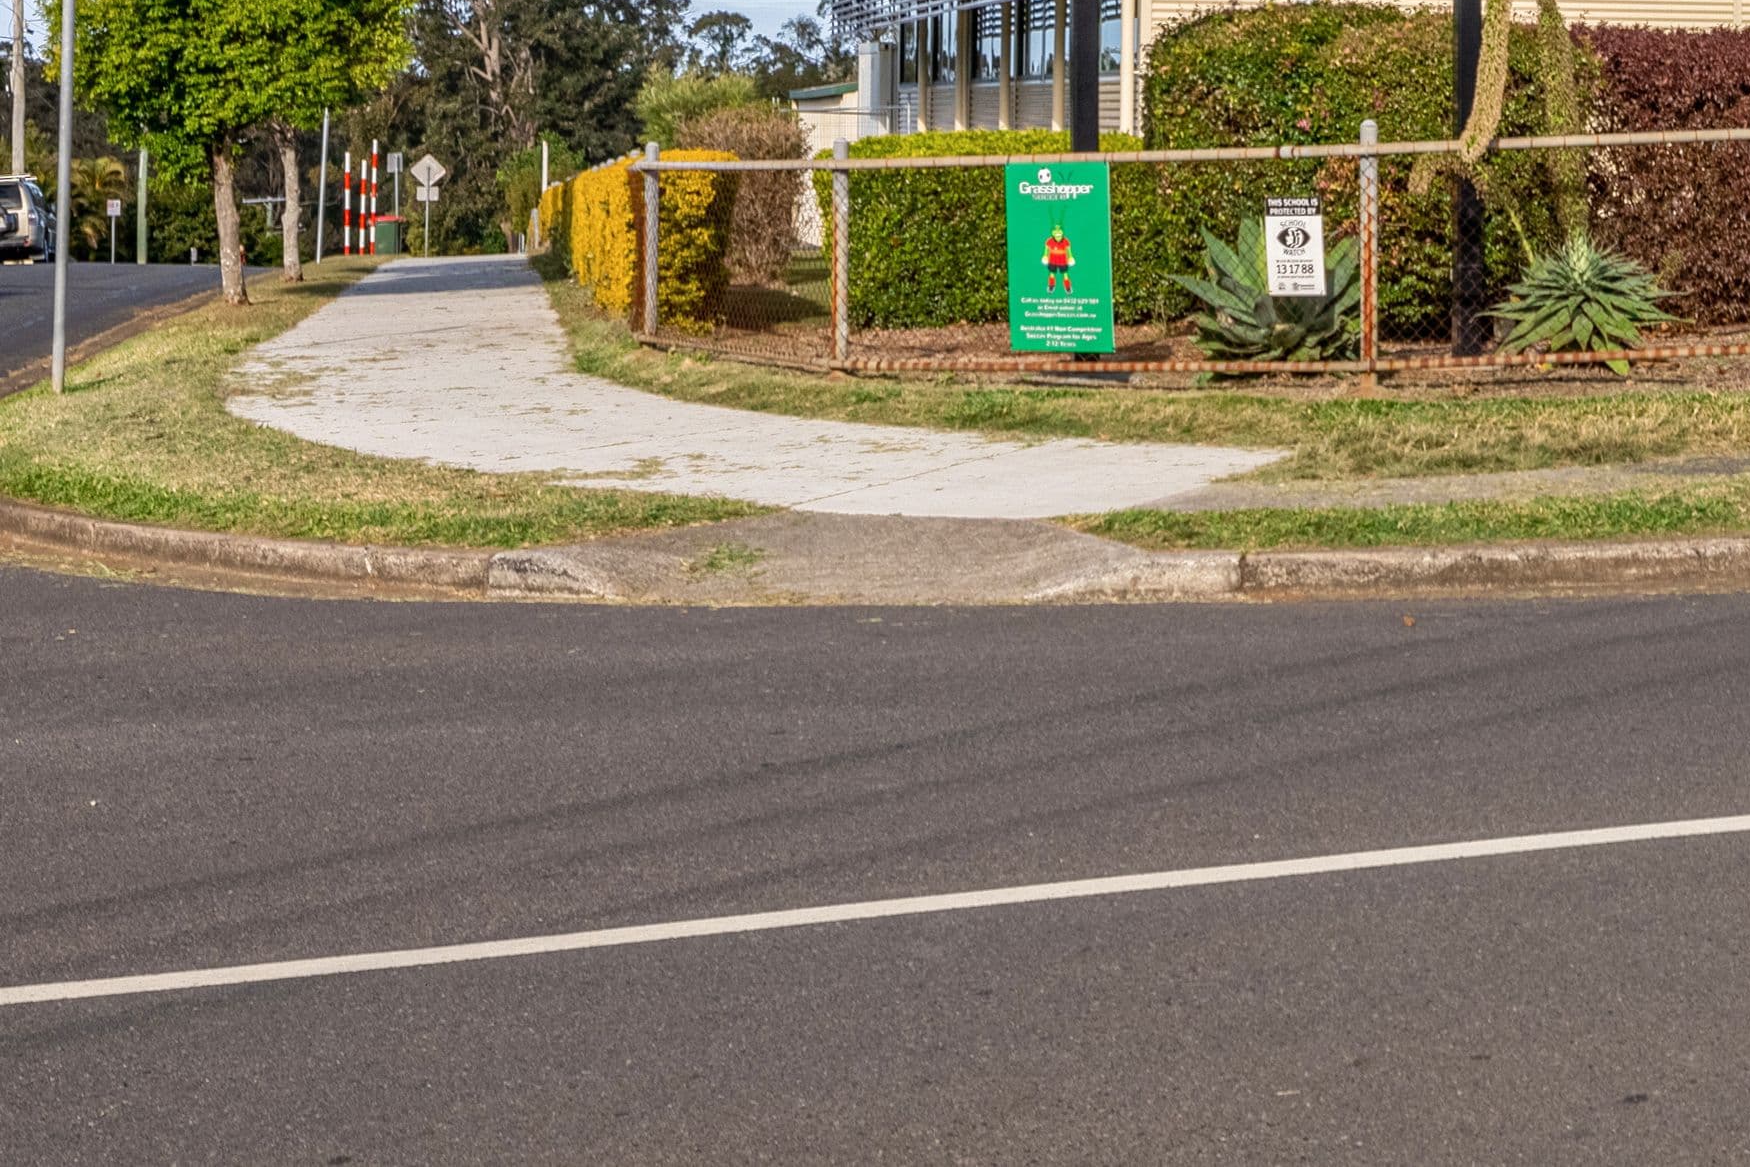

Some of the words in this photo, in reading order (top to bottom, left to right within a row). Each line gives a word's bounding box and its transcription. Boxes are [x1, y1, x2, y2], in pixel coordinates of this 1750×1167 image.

[1019, 182, 1094, 199] Grasshopper
[1268, 198, 1282, 206] THIS
[1283, 198, 1310, 206] SCHOOL
[1311, 198, 1318, 206] IS
[1269, 207, 1307, 215] PROTECTED
[1280, 220, 1307, 228] SCHOOL
[1276, 264, 1287, 274] 13
[1289, 264, 1300, 274] 17
[1301, 264, 1314, 274] 88
